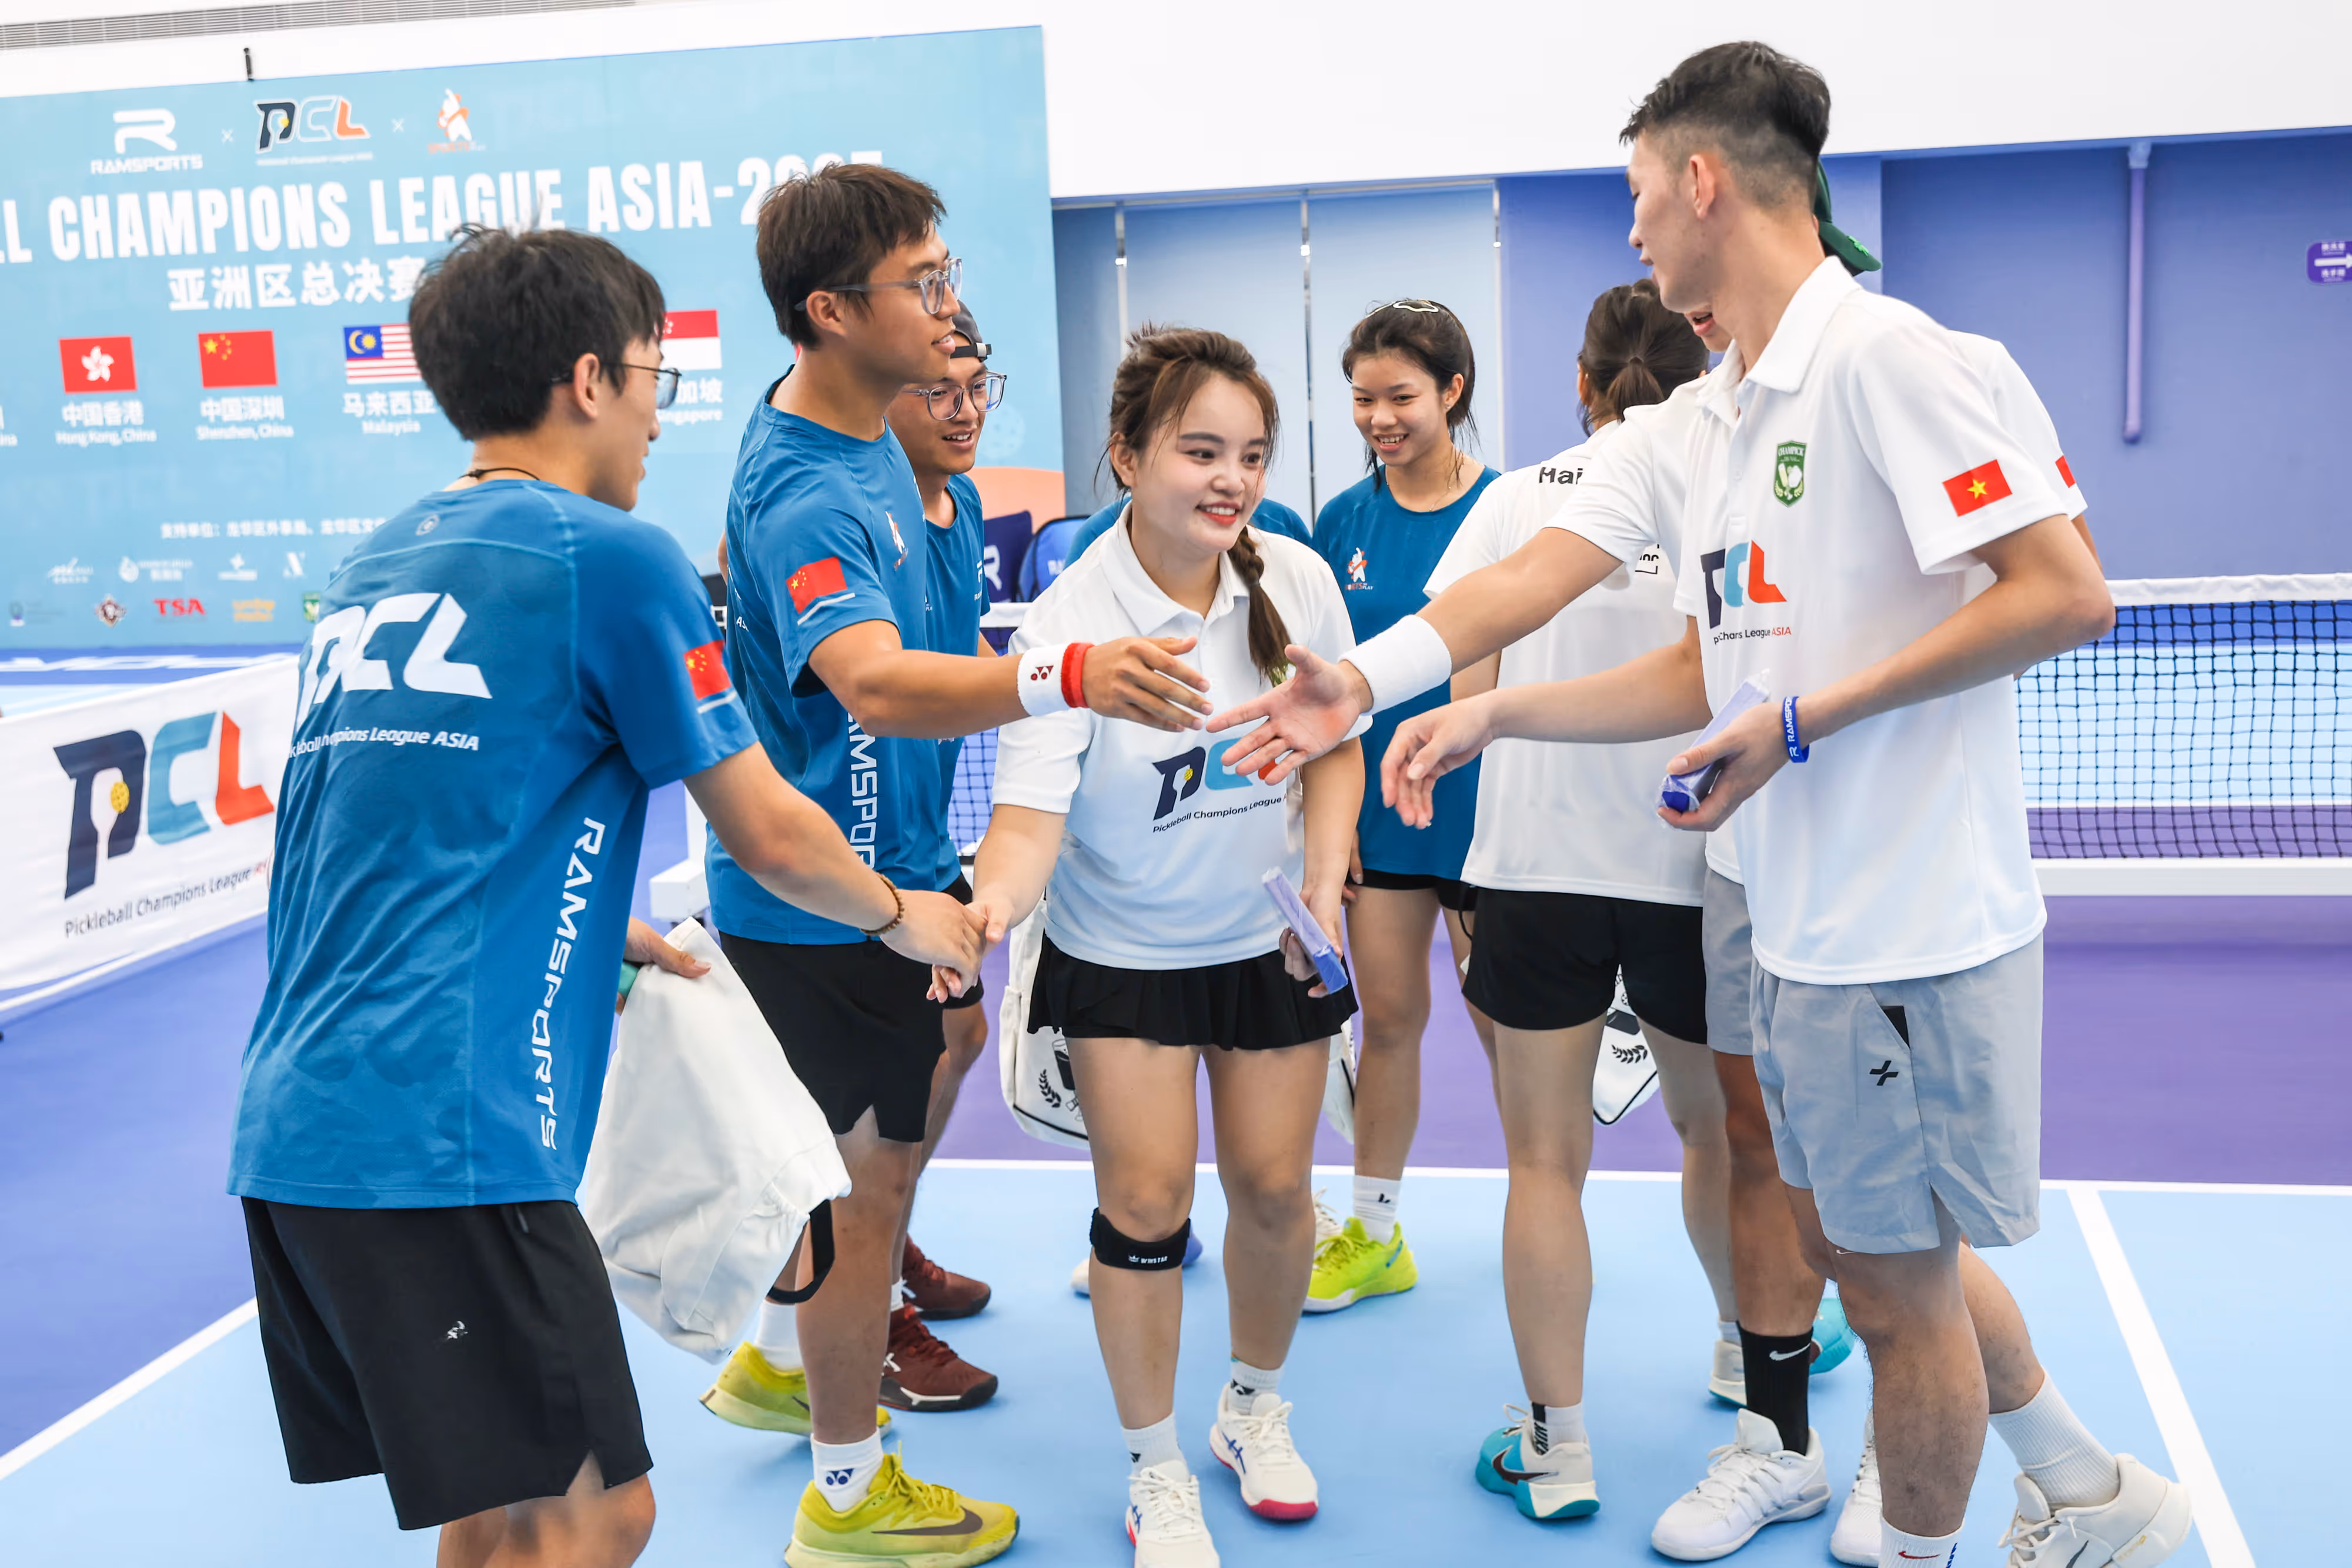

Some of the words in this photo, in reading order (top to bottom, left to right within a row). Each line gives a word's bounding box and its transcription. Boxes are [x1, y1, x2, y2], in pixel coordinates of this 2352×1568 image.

[90, 153, 203, 175] RAMSPORTS
[48, 181, 351, 261] CHAMPIONS
[369, 169, 566, 246] LEAGUE
[342, 390, 437, 417] 马来西亚
[675, 376, 723, 404] 加坡
[61, 400, 145, 427] 中国香港
[200, 396, 285, 422] 中国深圳
[362, 419, 421, 436] Malaysia
[1539, 466, 1583, 485] Hai
[152, 598, 206, 617] TSA
[1745, 627, 1770, 639] League
[1771, 626, 1792, 637] ASIA
[369, 727, 430, 747] League
[432, 731, 480, 751] ASIA
[53, 710, 275, 900] PCL
[1152, 812, 1192, 833] Pickleball
[1194, 805, 1248, 820] Champions
[1249, 795, 1282, 811] League
[64, 902, 133, 938] Pickleball
[136, 882, 207, 917] Champions
[208, 867, 252, 894] League
[531, 817, 606, 1151] RAMSPORTS
